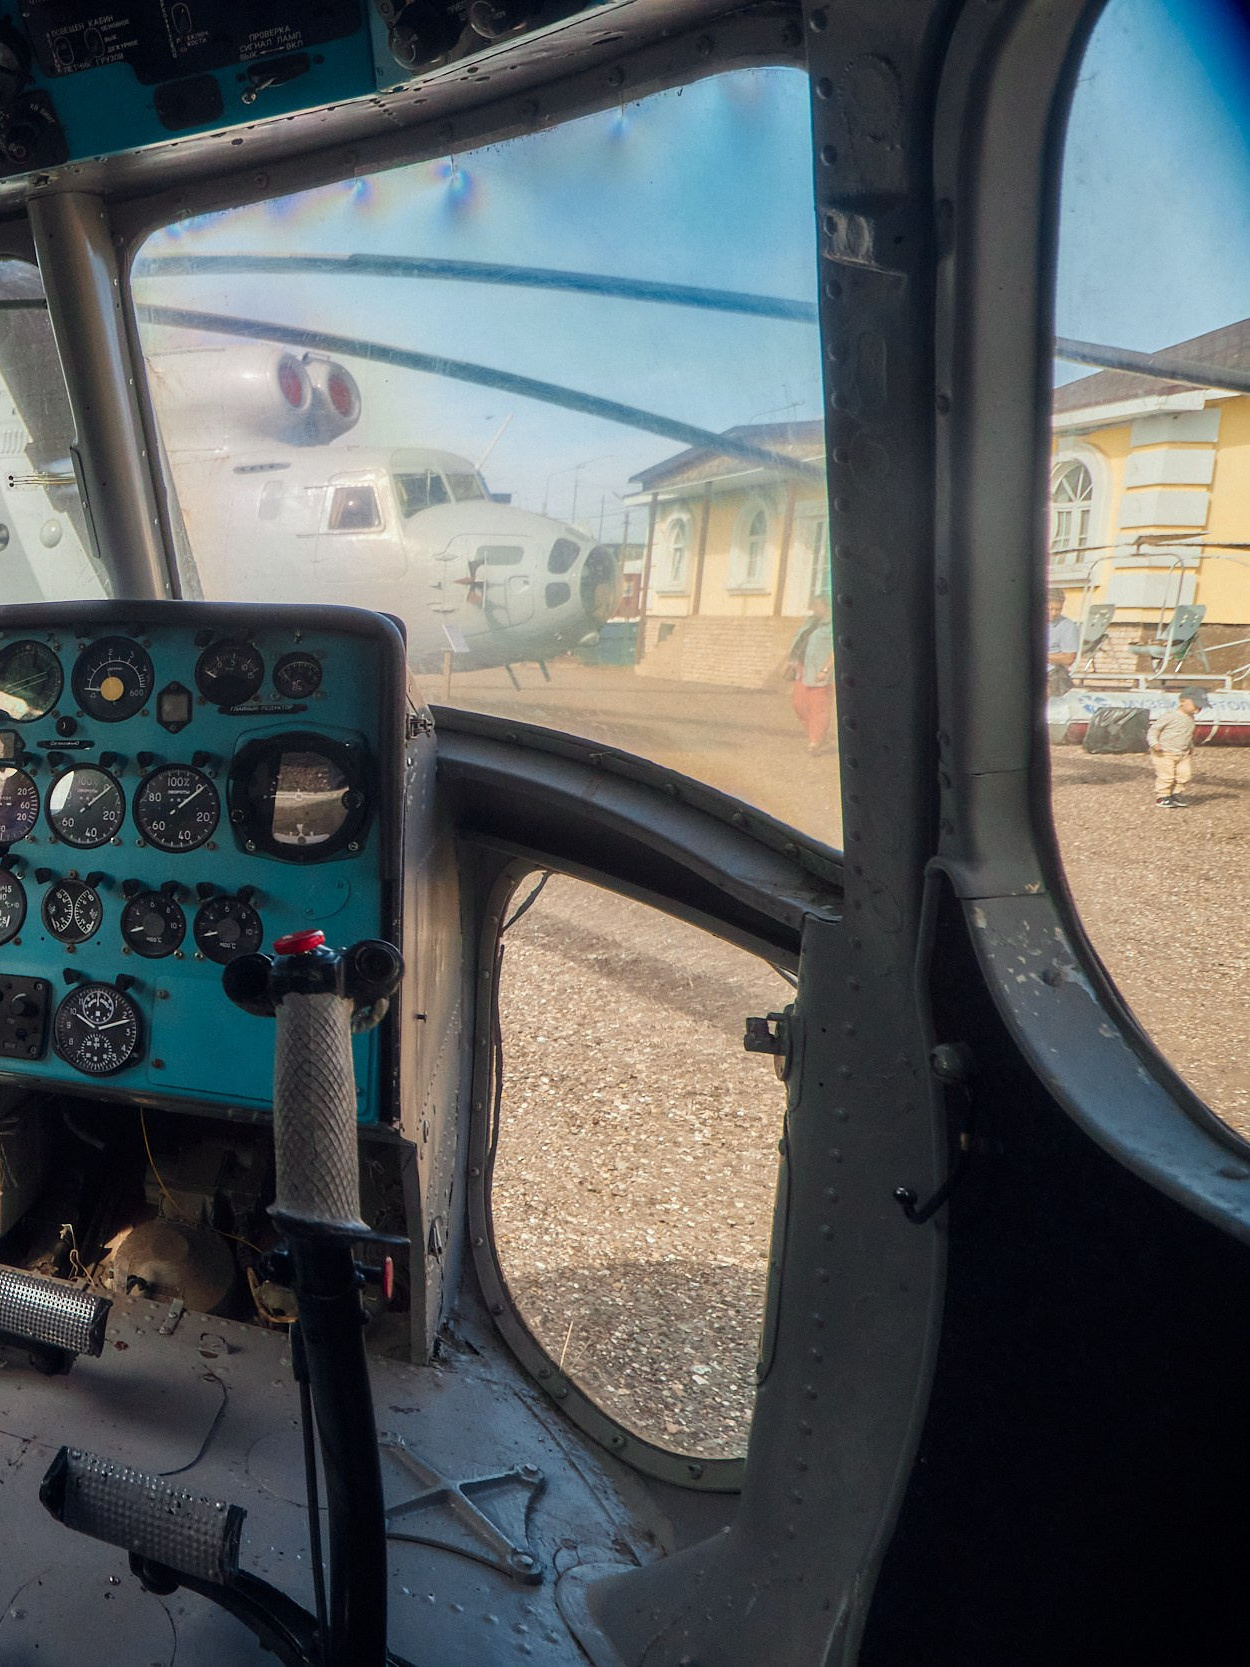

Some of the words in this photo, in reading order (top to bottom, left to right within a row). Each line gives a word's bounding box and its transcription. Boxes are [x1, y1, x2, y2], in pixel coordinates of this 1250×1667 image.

[87, 15, 114, 27] КАБИН
[248, 25, 291, 42] ПРОВЕРКА
[108, 648, 113, 656] 2
[129, 651, 135, 659] 3
[241, 663, 248, 671] 10
[130, 689, 144, 697] 600
[167, 777, 190, 787] 100%
[148, 792, 161, 802] 80
[20, 801, 30, 810] 60
[16, 813, 27, 821] 20
[102, 811, 115, 821] 20
[196, 811, 210, 822] 20
[61, 817, 74, 827] 60
[152, 821, 165, 831] 60
[85, 828, 98, 837] 40
[178, 830, 191, 840] 40
[5, 885, 12, 893] 15
[166, 906, 171, 914] 8
[245, 928, 253, 936] 10
[122, 1011, 127, 1019] 2
[125, 1028, 131, 1036] 3
[68, 1037, 74, 1045] 8
